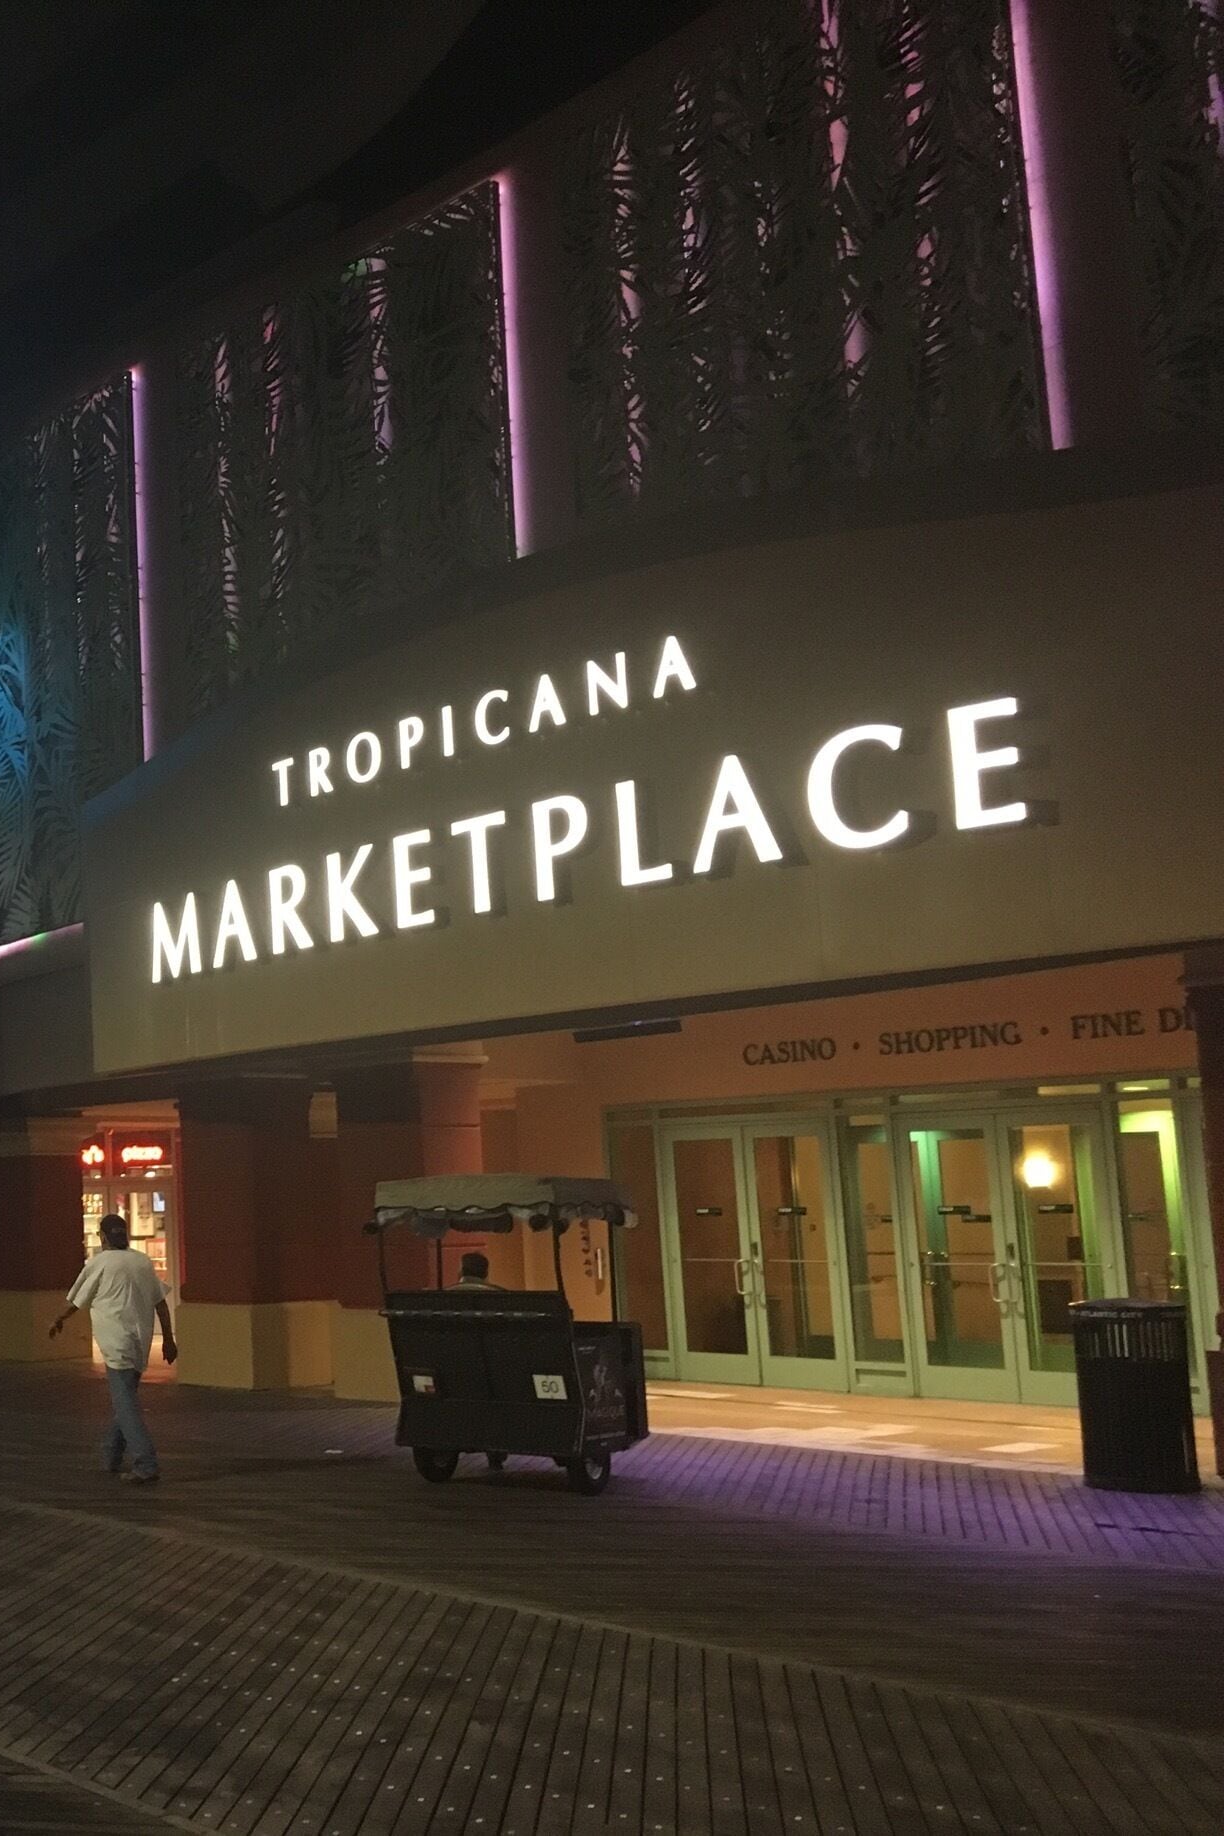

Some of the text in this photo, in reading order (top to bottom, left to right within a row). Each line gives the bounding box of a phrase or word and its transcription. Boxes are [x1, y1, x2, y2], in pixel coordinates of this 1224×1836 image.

[271, 635, 696, 807] TROPICANA
[150, 696, 1028, 985] MARKETPLACE
[742, 1037, 836, 1066] CASINO
[878, 1022, 1022, 1055] SHOPPING
[1070, 1008, 1146, 1040] FINE
[541, 1381, 559, 1394] 50
